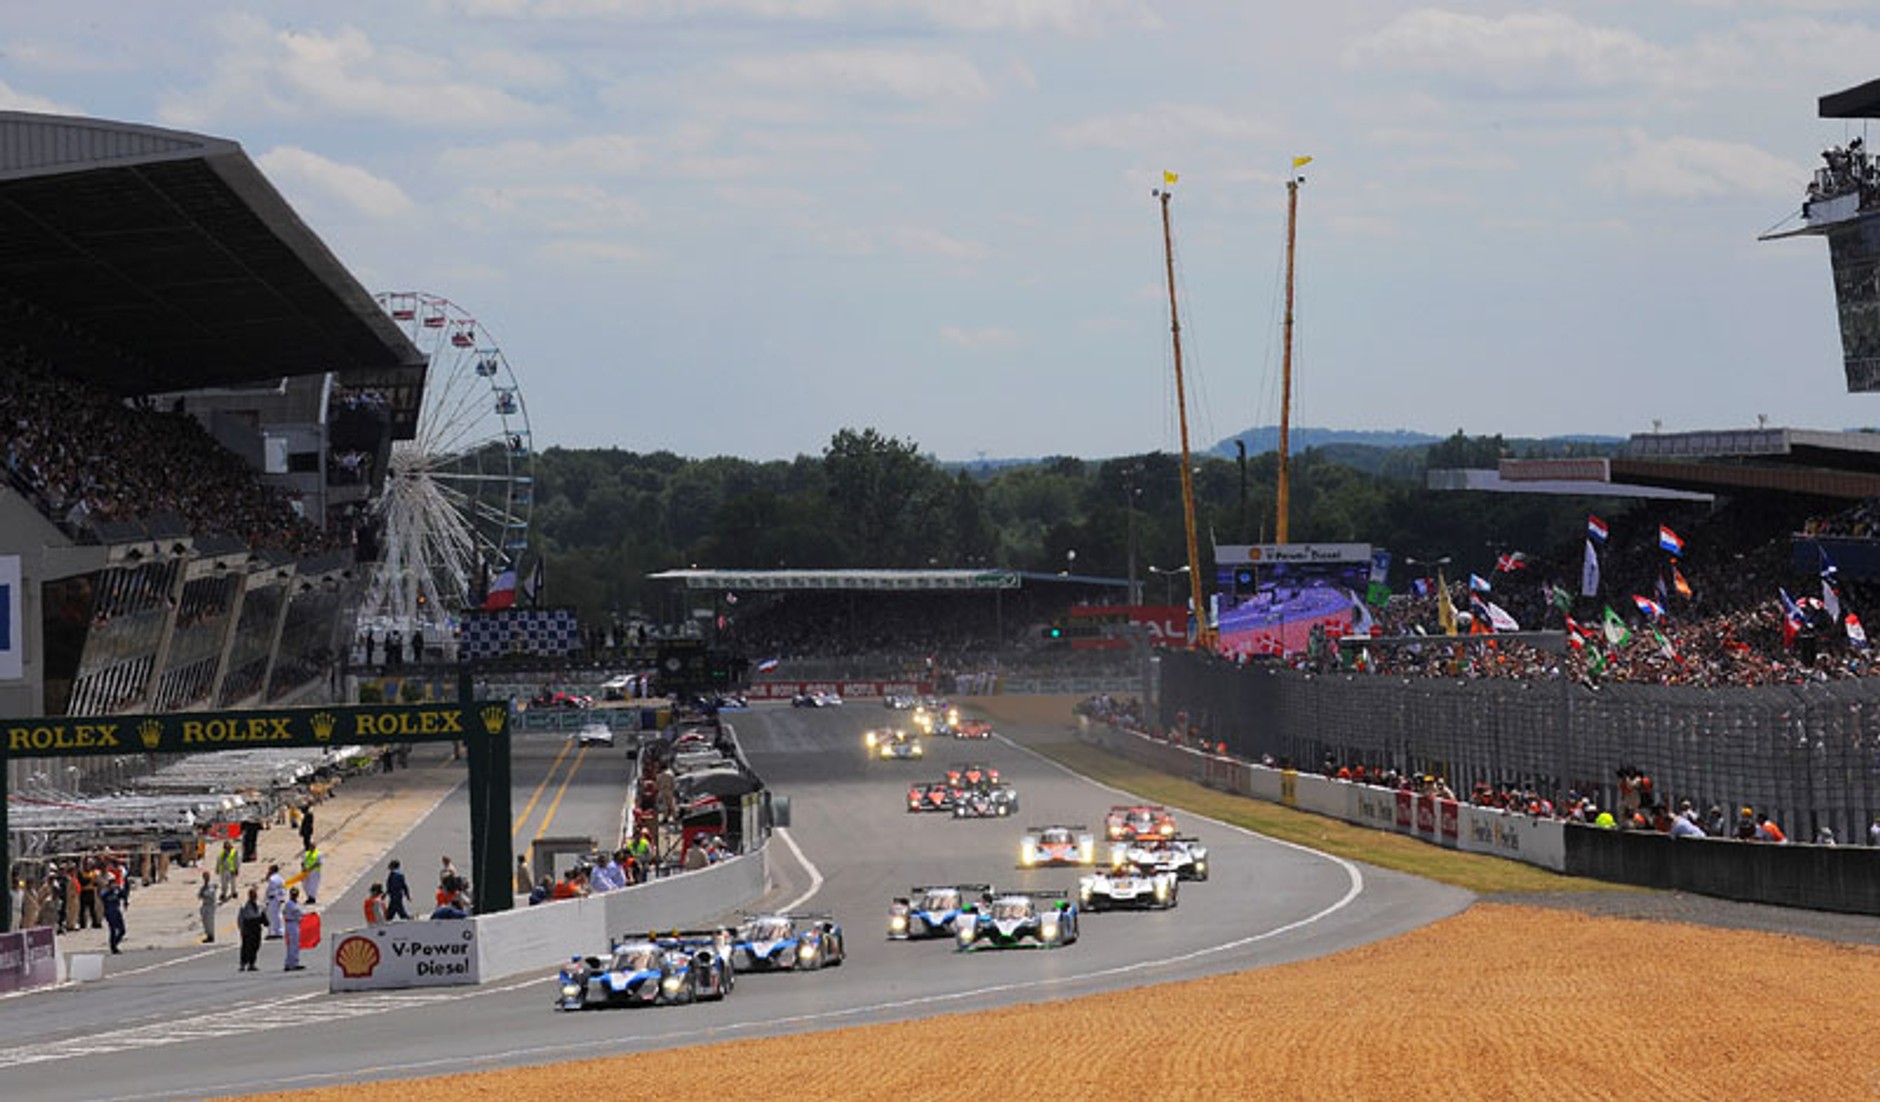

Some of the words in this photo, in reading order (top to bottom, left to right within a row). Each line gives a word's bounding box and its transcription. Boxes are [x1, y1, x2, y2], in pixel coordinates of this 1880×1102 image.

[8, 725, 120, 750] ROLEX
[182, 718, 292, 744] ROLEX
[355, 710, 463, 735] ROLEX
[392, 942, 469, 957] V-Power
[416, 958, 469, 976] Diesel
